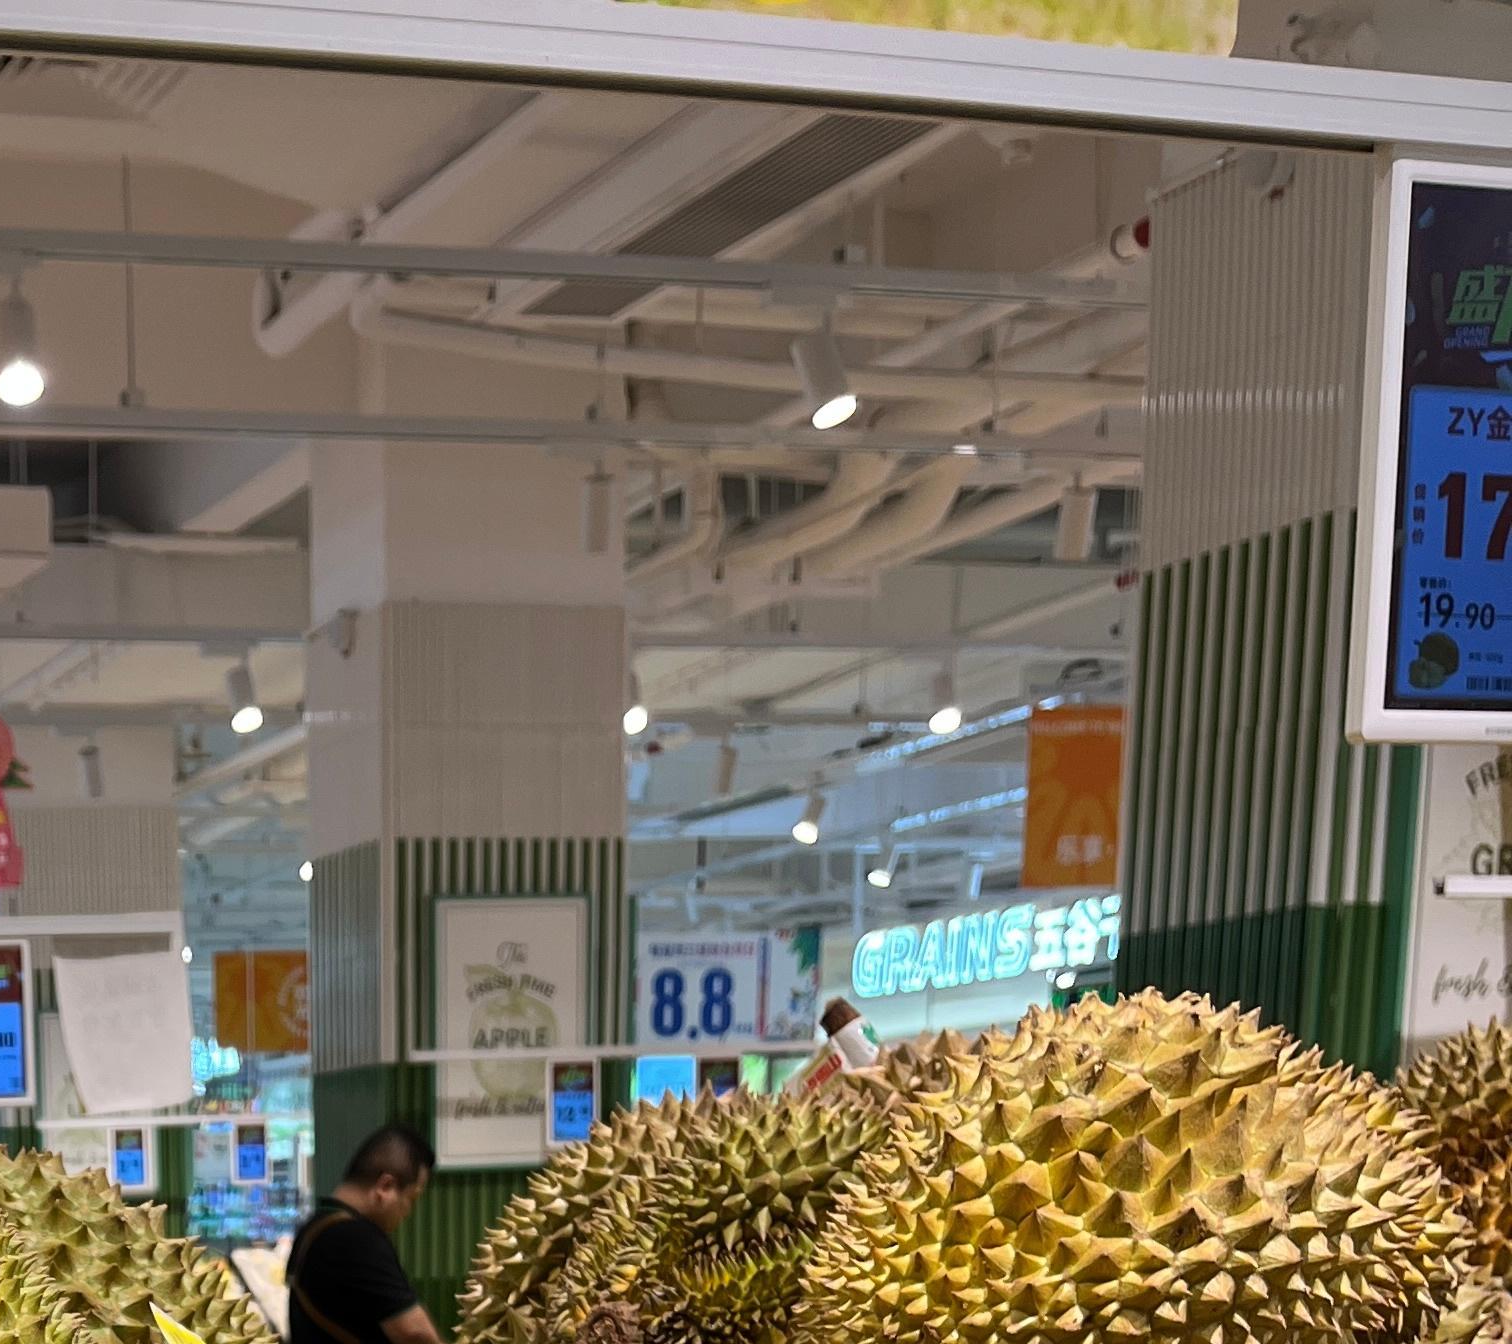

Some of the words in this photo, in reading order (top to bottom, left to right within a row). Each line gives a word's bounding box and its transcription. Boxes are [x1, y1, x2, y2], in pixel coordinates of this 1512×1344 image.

[1420, 592, 1496, 630] 19.90
[852, 903, 1037, 998] GRAINS
[473, 1027, 550, 1050] APPLE
